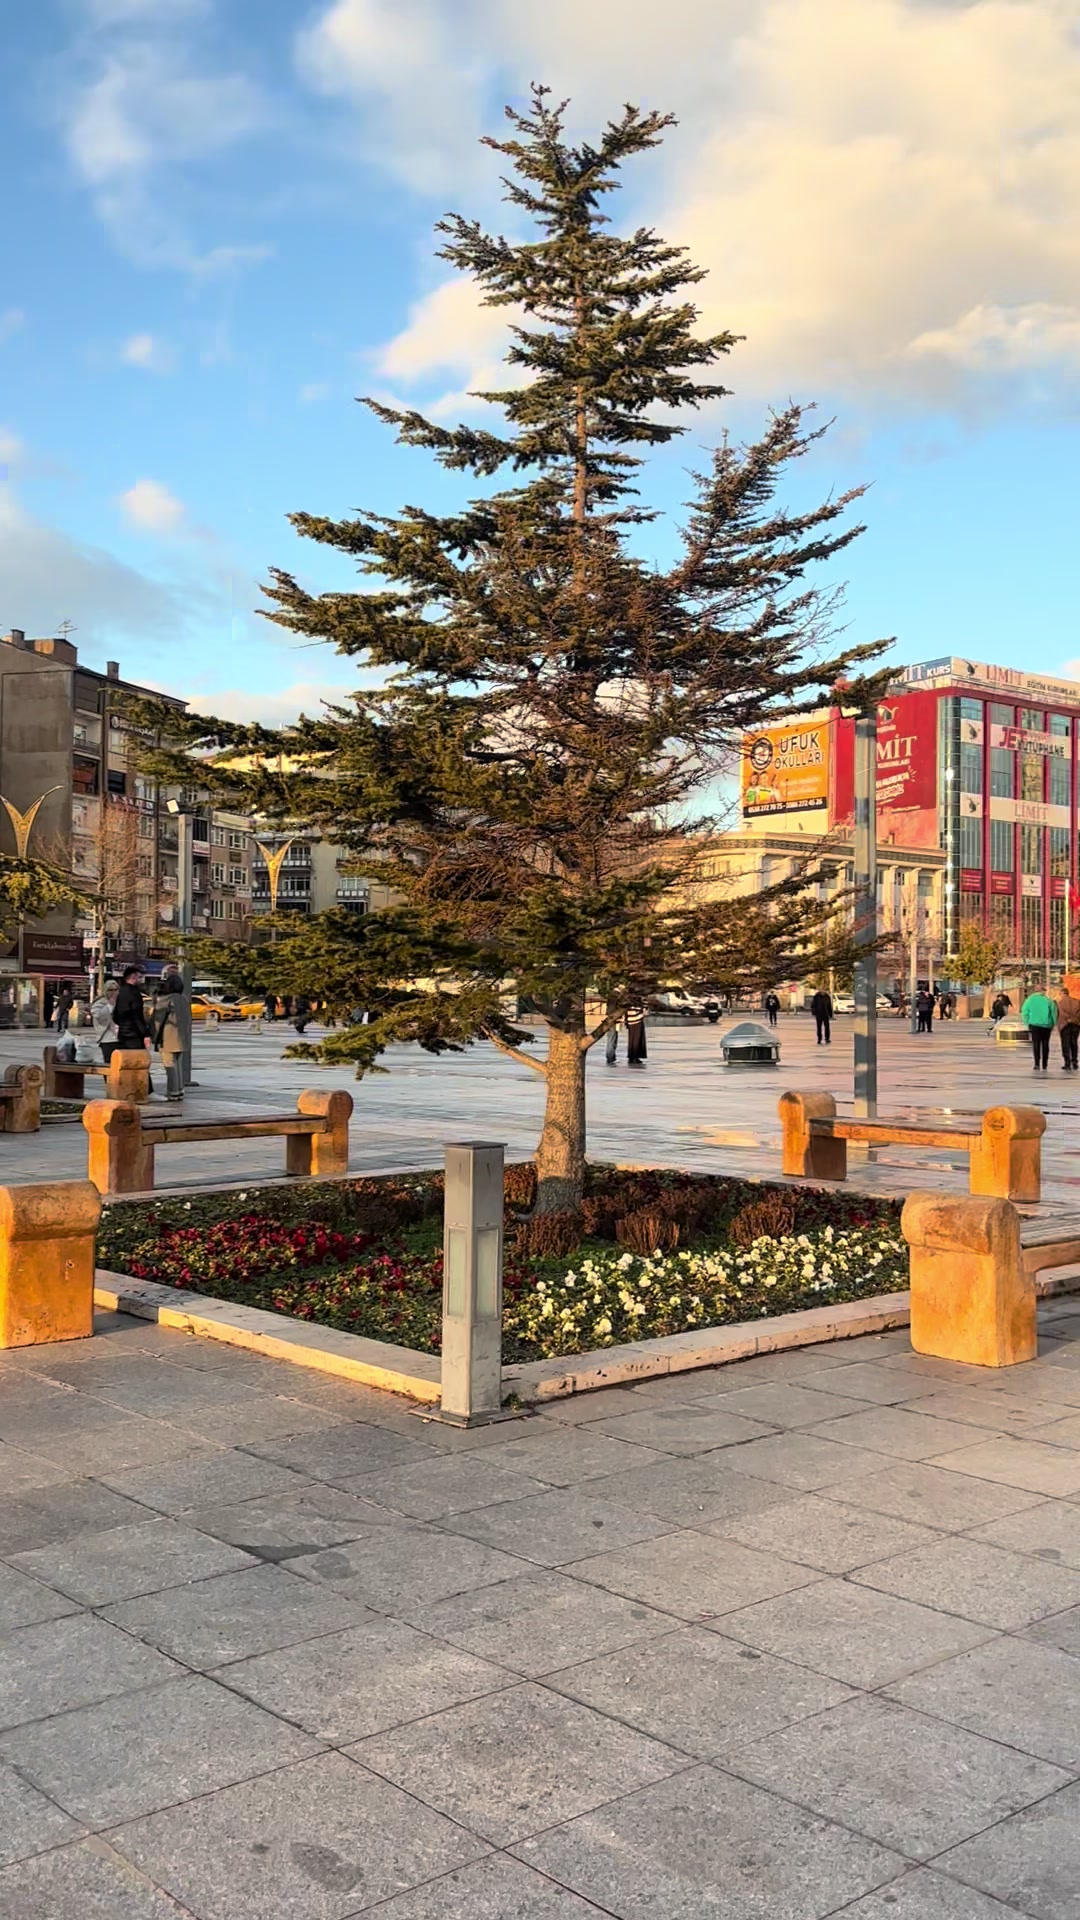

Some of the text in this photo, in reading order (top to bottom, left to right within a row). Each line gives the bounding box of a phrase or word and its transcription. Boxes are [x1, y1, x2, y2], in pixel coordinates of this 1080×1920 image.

[926, 664, 951, 678] KURS
[780, 732, 819, 754] UFUK
[876, 733, 917, 762] MİT
[1000, 726, 1027, 749] JET
[774, 751, 825, 770] OKULLARI
